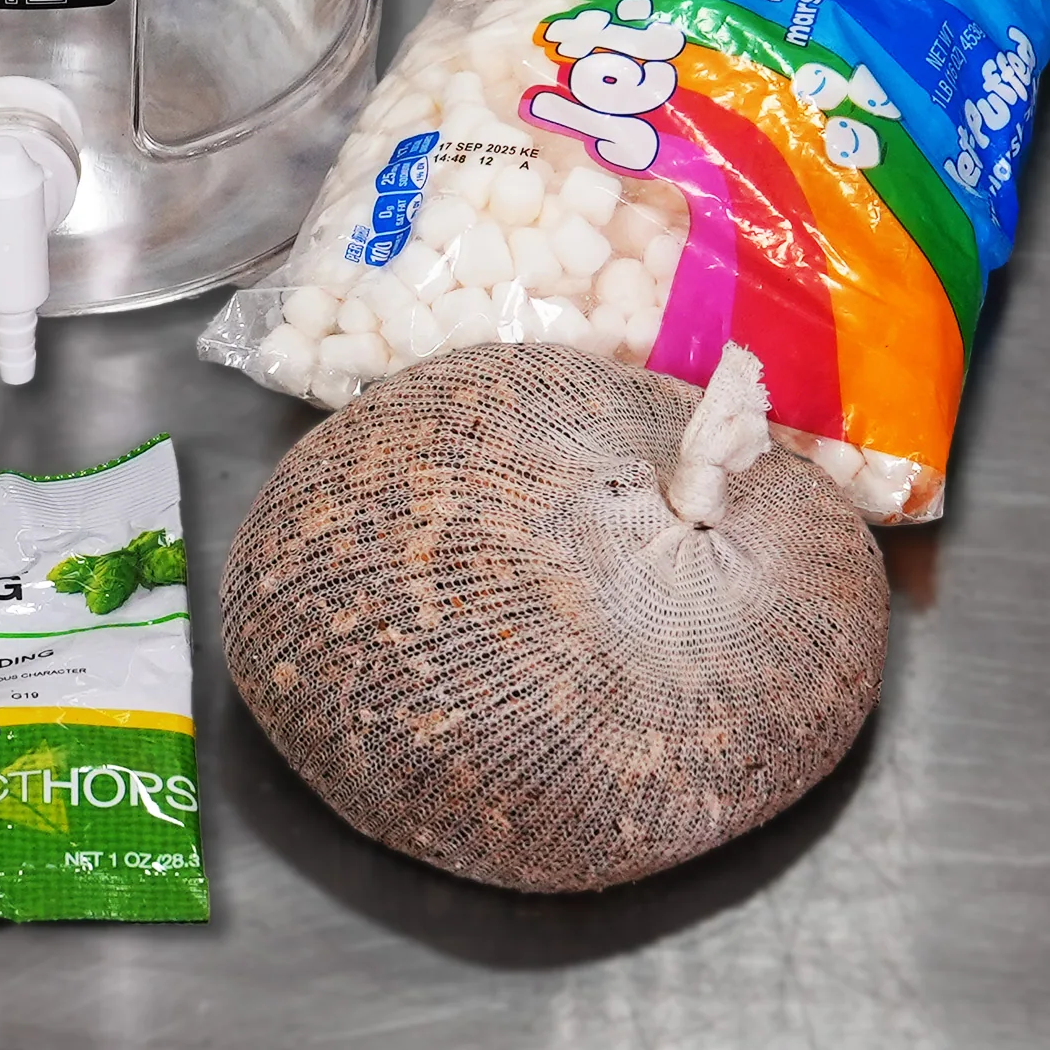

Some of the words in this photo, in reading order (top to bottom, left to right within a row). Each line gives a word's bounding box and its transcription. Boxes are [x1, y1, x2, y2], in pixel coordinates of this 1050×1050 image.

[926, 39, 948, 71] NET
[935, 80, 953, 103] LB
[439, 142, 452, 151] 17
[455, 142, 483, 152] SEP
[485, 144, 517, 155] 2025
[519, 147, 540, 159] KE
[433, 153, 467, 164] 14:48
[479, 156, 494, 166] 12
[518, 161, 530, 171] A
[20, 667, 87, 679] CHARACTER
[64, 851, 104, 869] NET
[109, 851, 117, 868] 1
[124, 851, 150, 869] OZ
